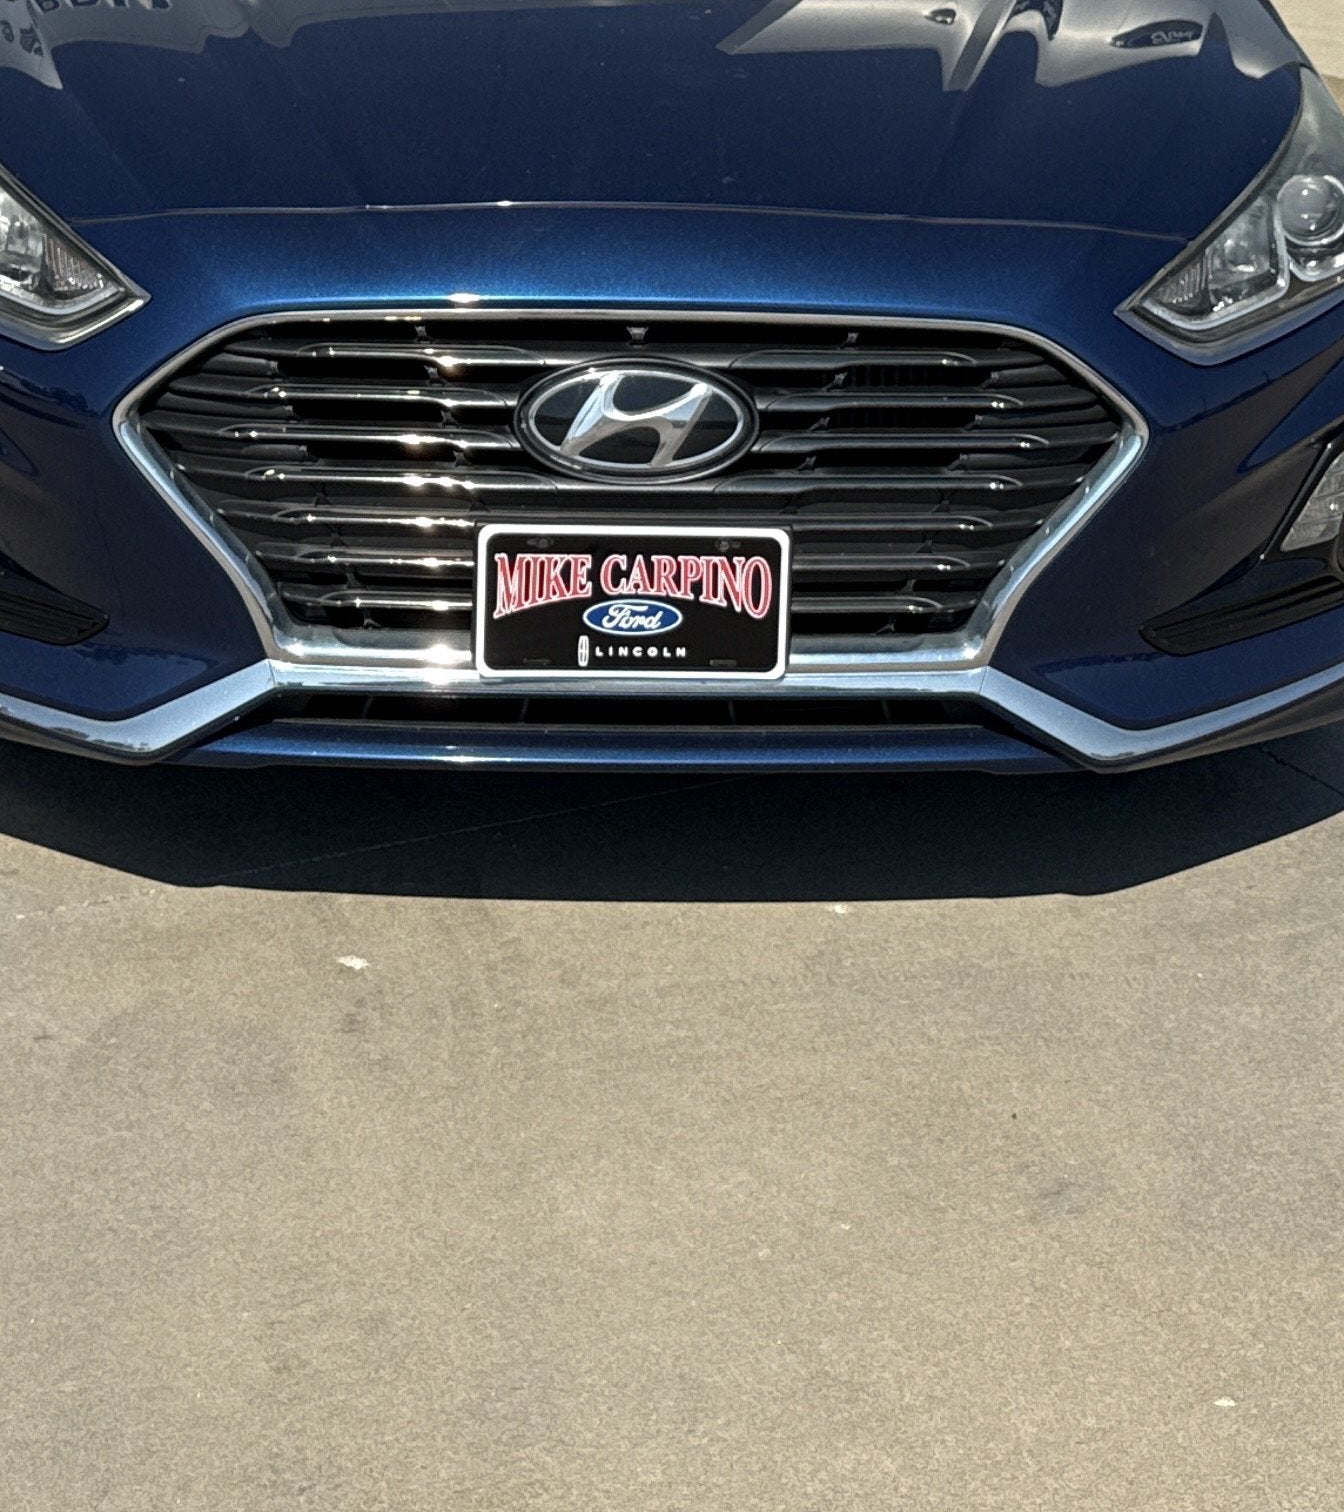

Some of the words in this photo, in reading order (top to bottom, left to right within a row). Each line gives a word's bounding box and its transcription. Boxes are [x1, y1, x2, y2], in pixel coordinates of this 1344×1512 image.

[493, 553, 592, 619] MIKE
[599, 554, 773, 619] CARPINO
[602, 604, 662, 631] Ford
[595, 646, 686, 658] LINCOLN
